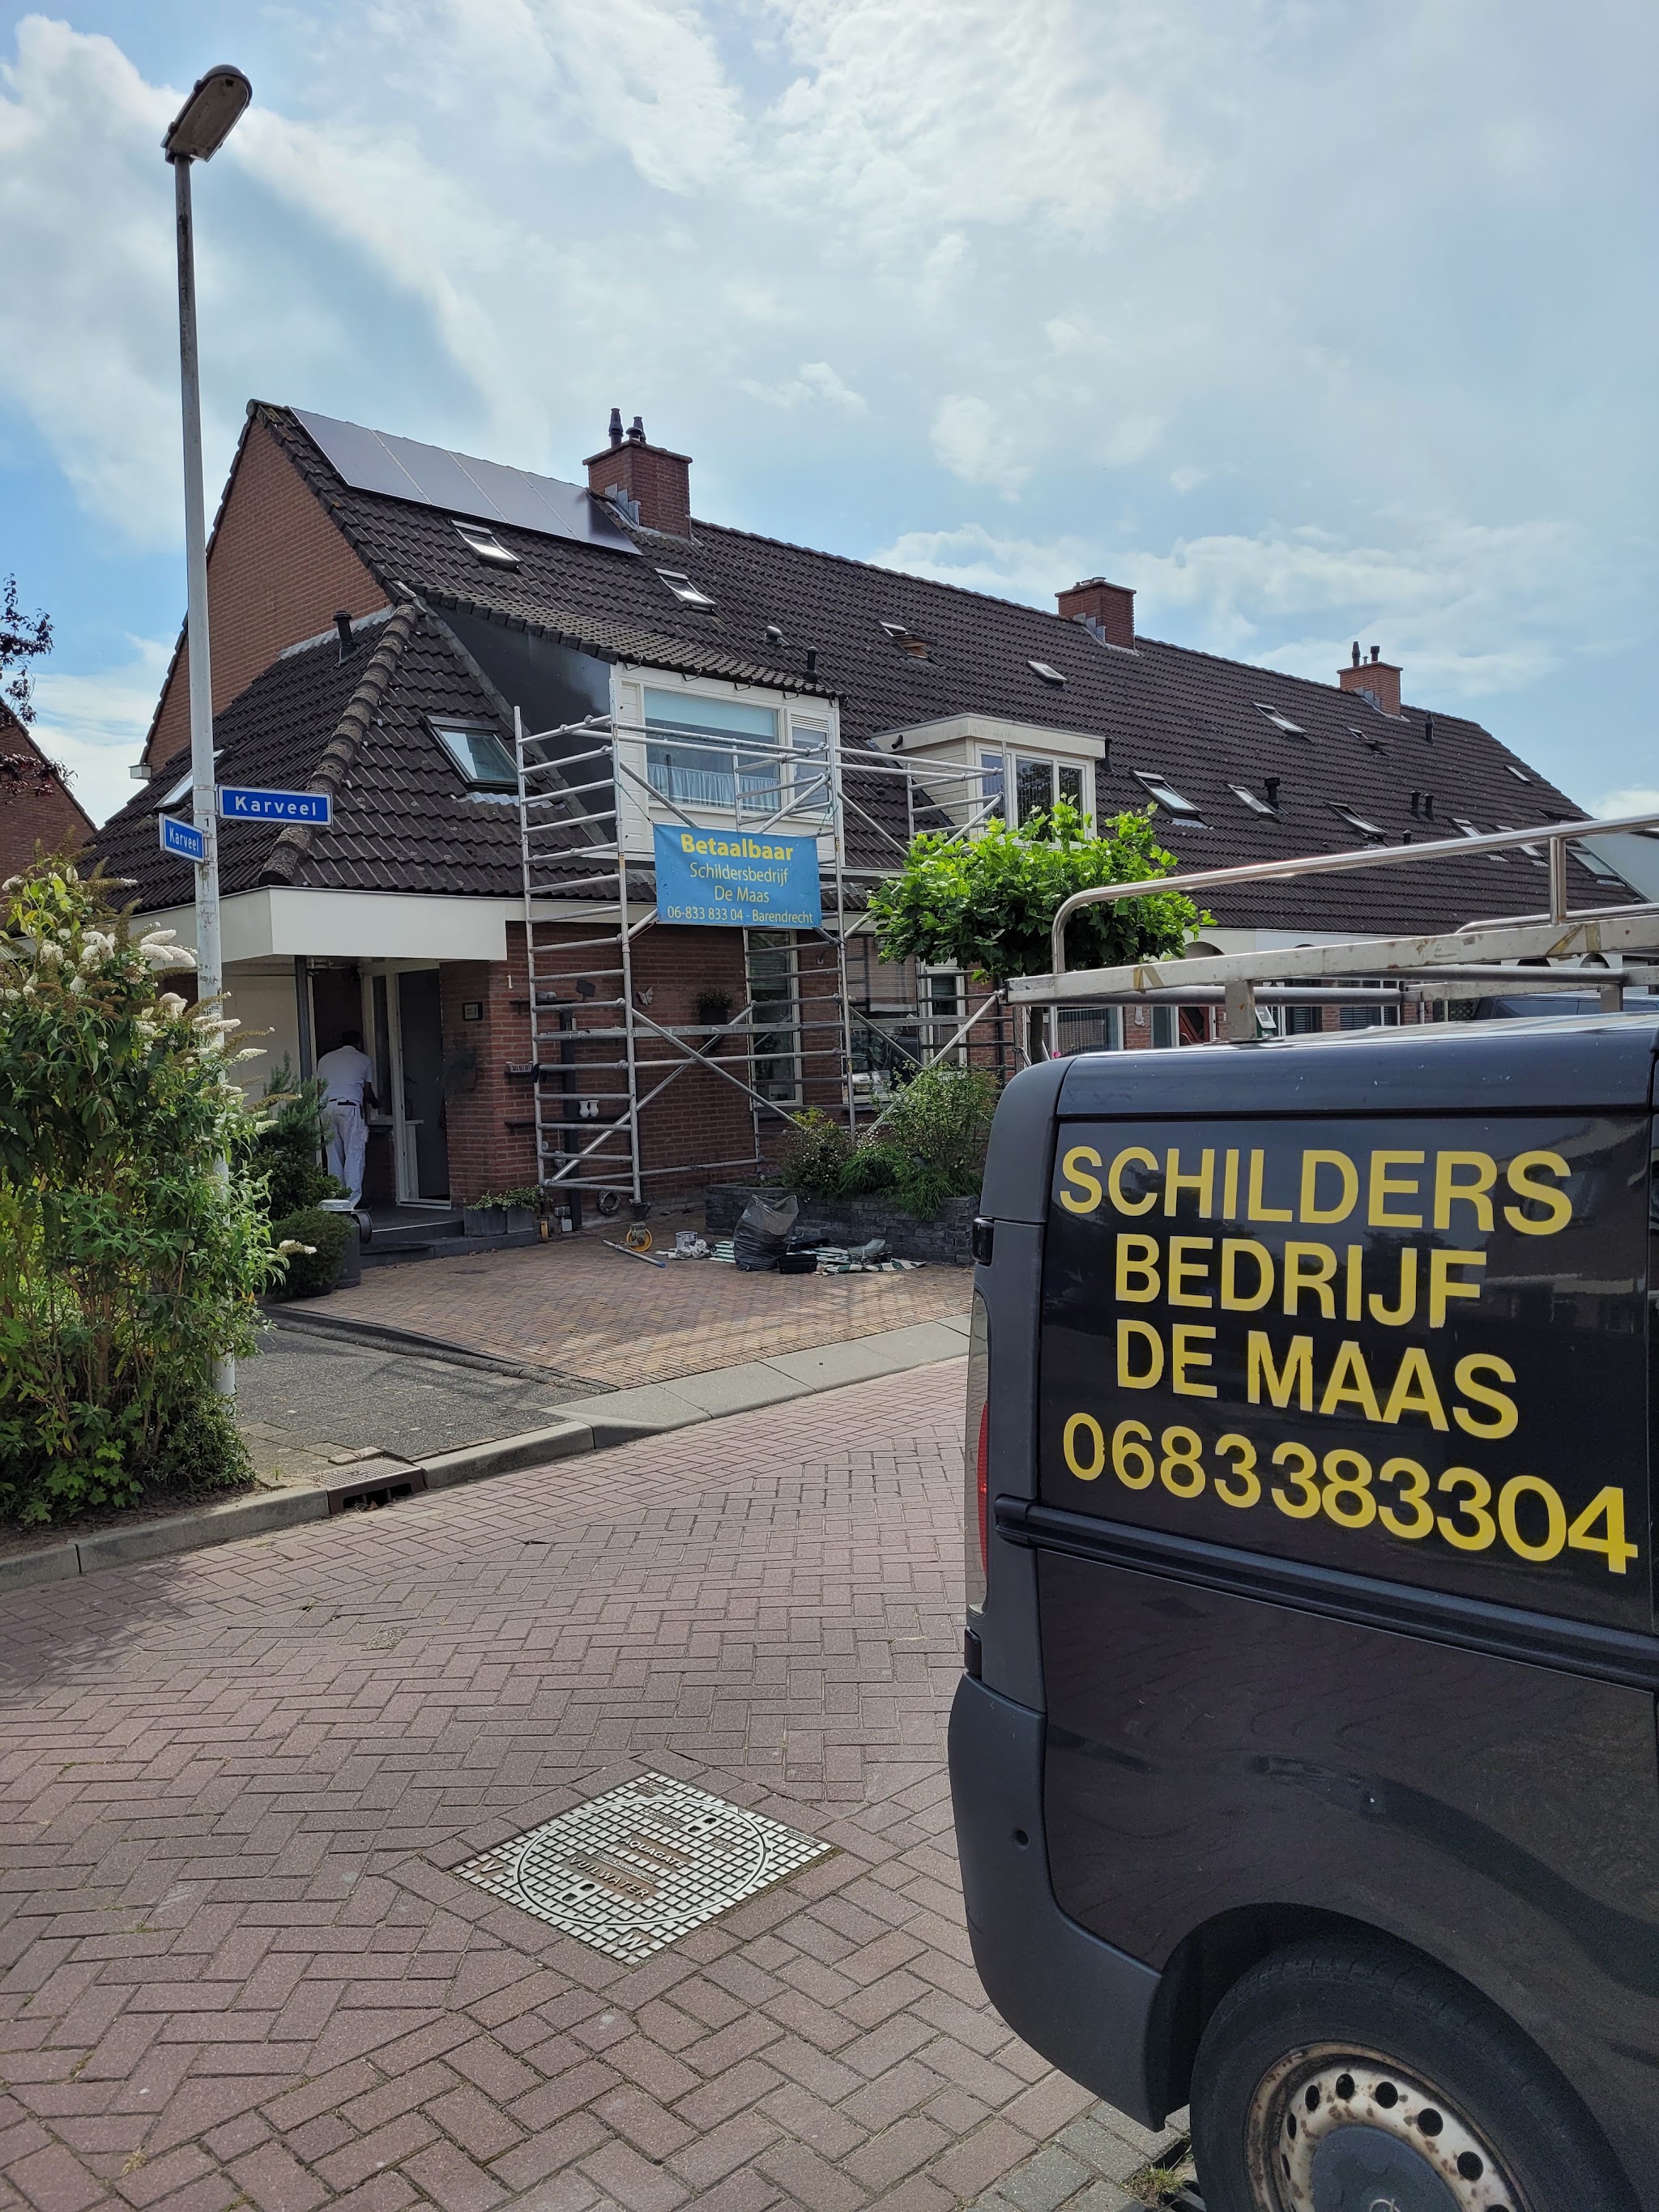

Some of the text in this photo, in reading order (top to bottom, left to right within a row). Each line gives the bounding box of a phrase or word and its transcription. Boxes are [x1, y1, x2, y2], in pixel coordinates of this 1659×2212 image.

[235, 795, 317, 816] Karveel
[204, 817, 209, 827] 1
[169, 826, 199, 852] Karveel
[680, 833, 794, 861] Betaalbaar
[690, 862, 788, 887] Schildersbedrijf
[714, 885, 770, 903] De Maas
[667, 906, 706, 920] 06-833
[708, 907, 728, 921] 833
[730, 908, 744, 922] 04
[753, 909, 813, 924] Barendrecht
[506, 974, 514, 990] 1
[1060, 1144, 1572, 1236] SCHILDERS
[1115, 1232, 1487, 1329] BEDRIJF
[1116, 1318, 1519, 1440] DE MAAS
[1062, 1411, 1639, 1575] 0683383304
[620, 1837, 688, 1869] AQUAGATE
[480, 1860, 504, 1873] V
[569, 1856, 650, 1899] VUILWATER
[618, 1933, 650, 1951] W
